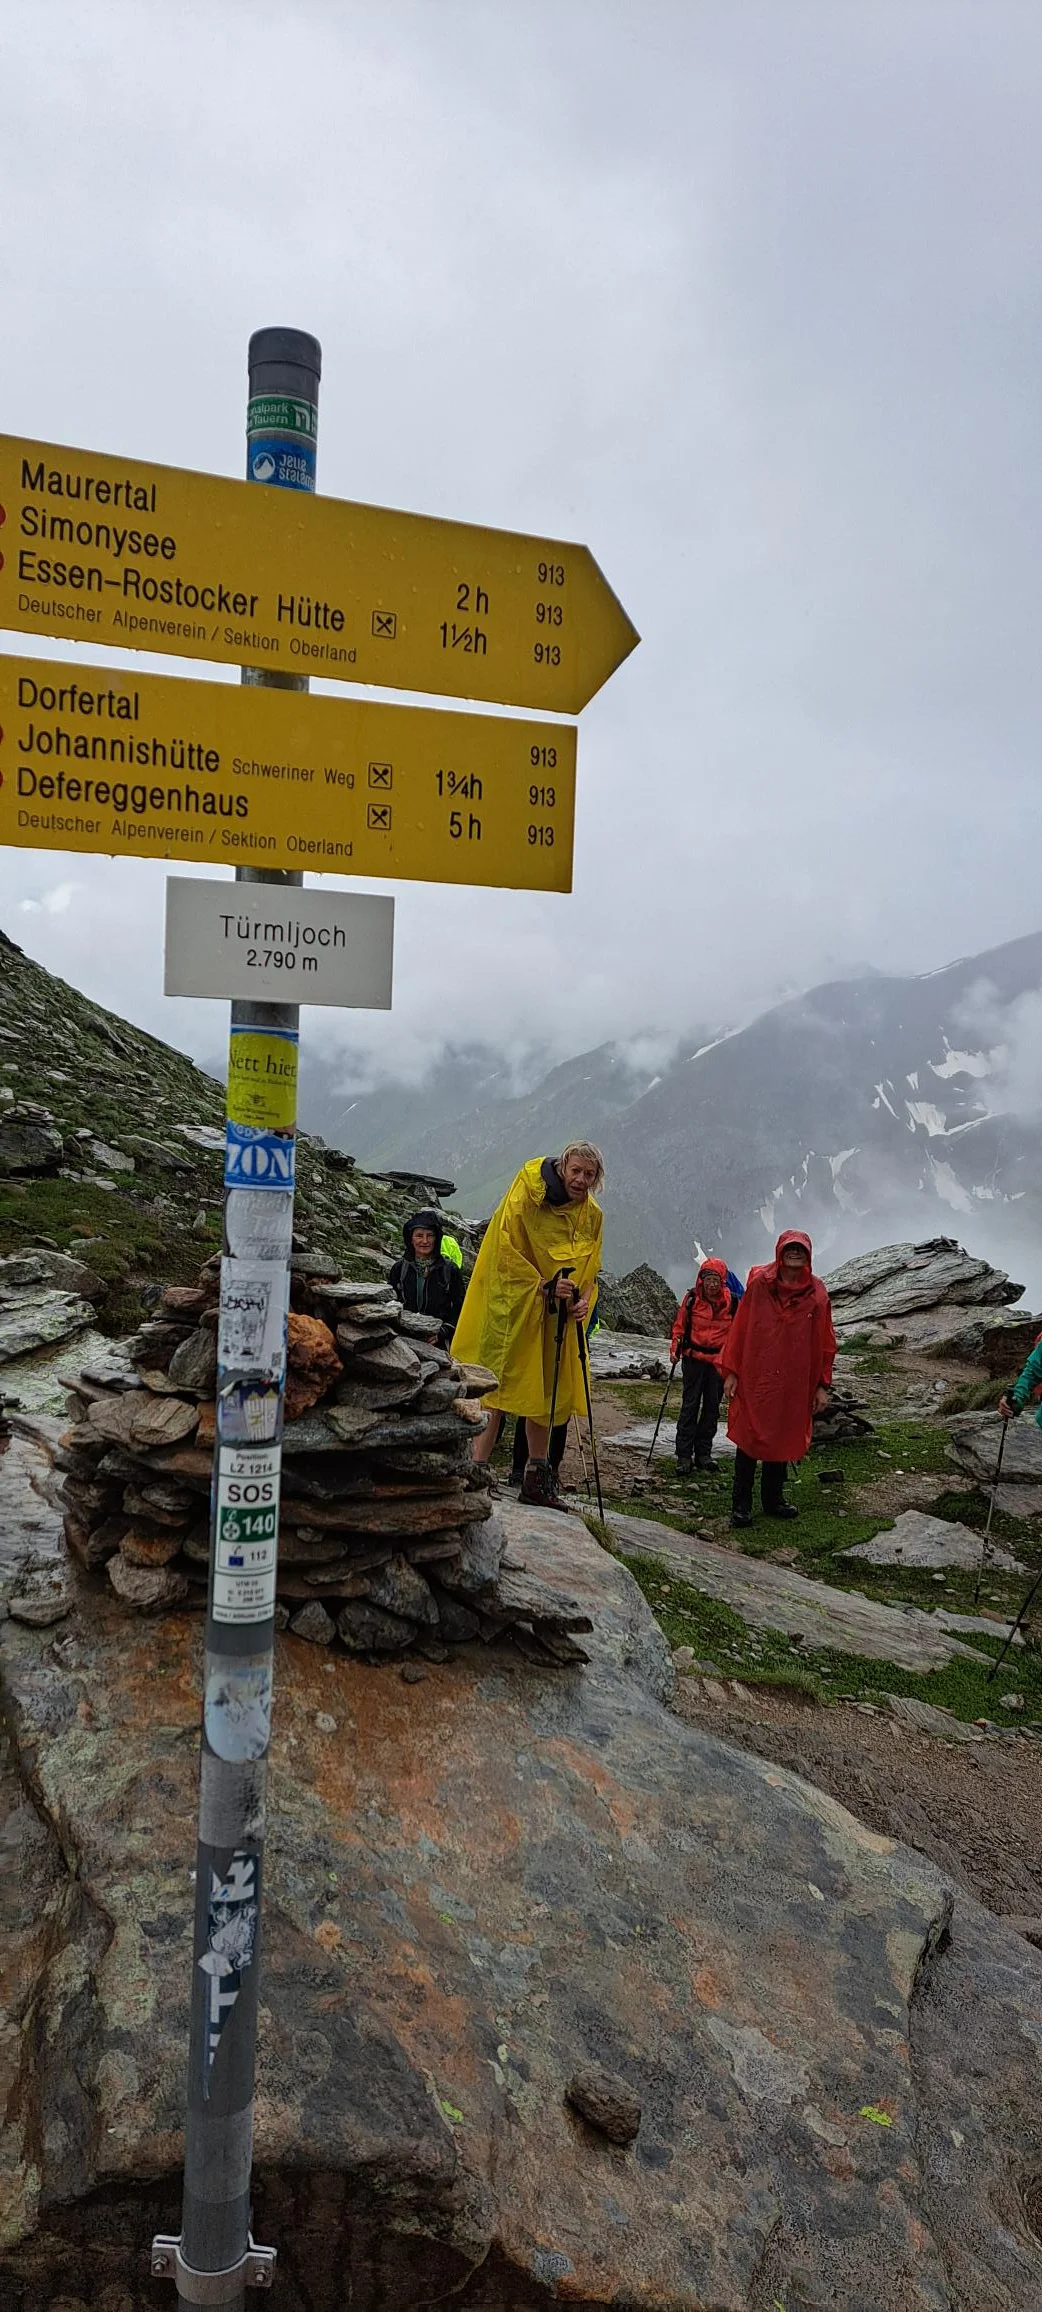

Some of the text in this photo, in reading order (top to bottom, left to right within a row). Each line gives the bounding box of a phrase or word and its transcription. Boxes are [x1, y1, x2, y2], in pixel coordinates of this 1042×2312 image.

[253, 414, 288, 425] Tauern
[21, 459, 156, 512] Maurertal
[20, 505, 177, 560] Simonysee
[537, 562, 565, 586] 913
[456, 583, 489, 614] 2 h
[277, 593, 345, 631] Hütte
[535, 602, 563, 626] 913
[18, 593, 102, 623] Deutscher
[112, 609, 206, 640] Alpenverein
[224, 627, 280, 652] Sektion
[290, 638, 357, 663] Oberland
[533, 642, 561, 666] 913
[18, 677, 139, 721] Dorfertal
[18, 723, 355, 789] Johannishütte Schweriner Weg
[530, 745, 557, 768] 913
[18, 766, 249, 818] Defereggenhaus
[529, 785, 556, 807] 913
[18, 809, 102, 833] Deutscher
[111, 818, 204, 843] Alpenverein
[221, 829, 276, 849] Sektion
[286, 835, 353, 856] Oberland
[450, 811, 481, 840] 5 h
[527, 824, 554, 846] 913
[219, 914, 346, 948] Türmljoch
[246, 949, 318, 972] 2.790 m
[226, 1142, 295, 1178] ZON
[229, 1462, 273, 1475] LZ 1214
[228, 1482, 273, 1503] SOS
[242, 1512, 275, 1536] 140
[250, 1549, 267, 1561] 112
